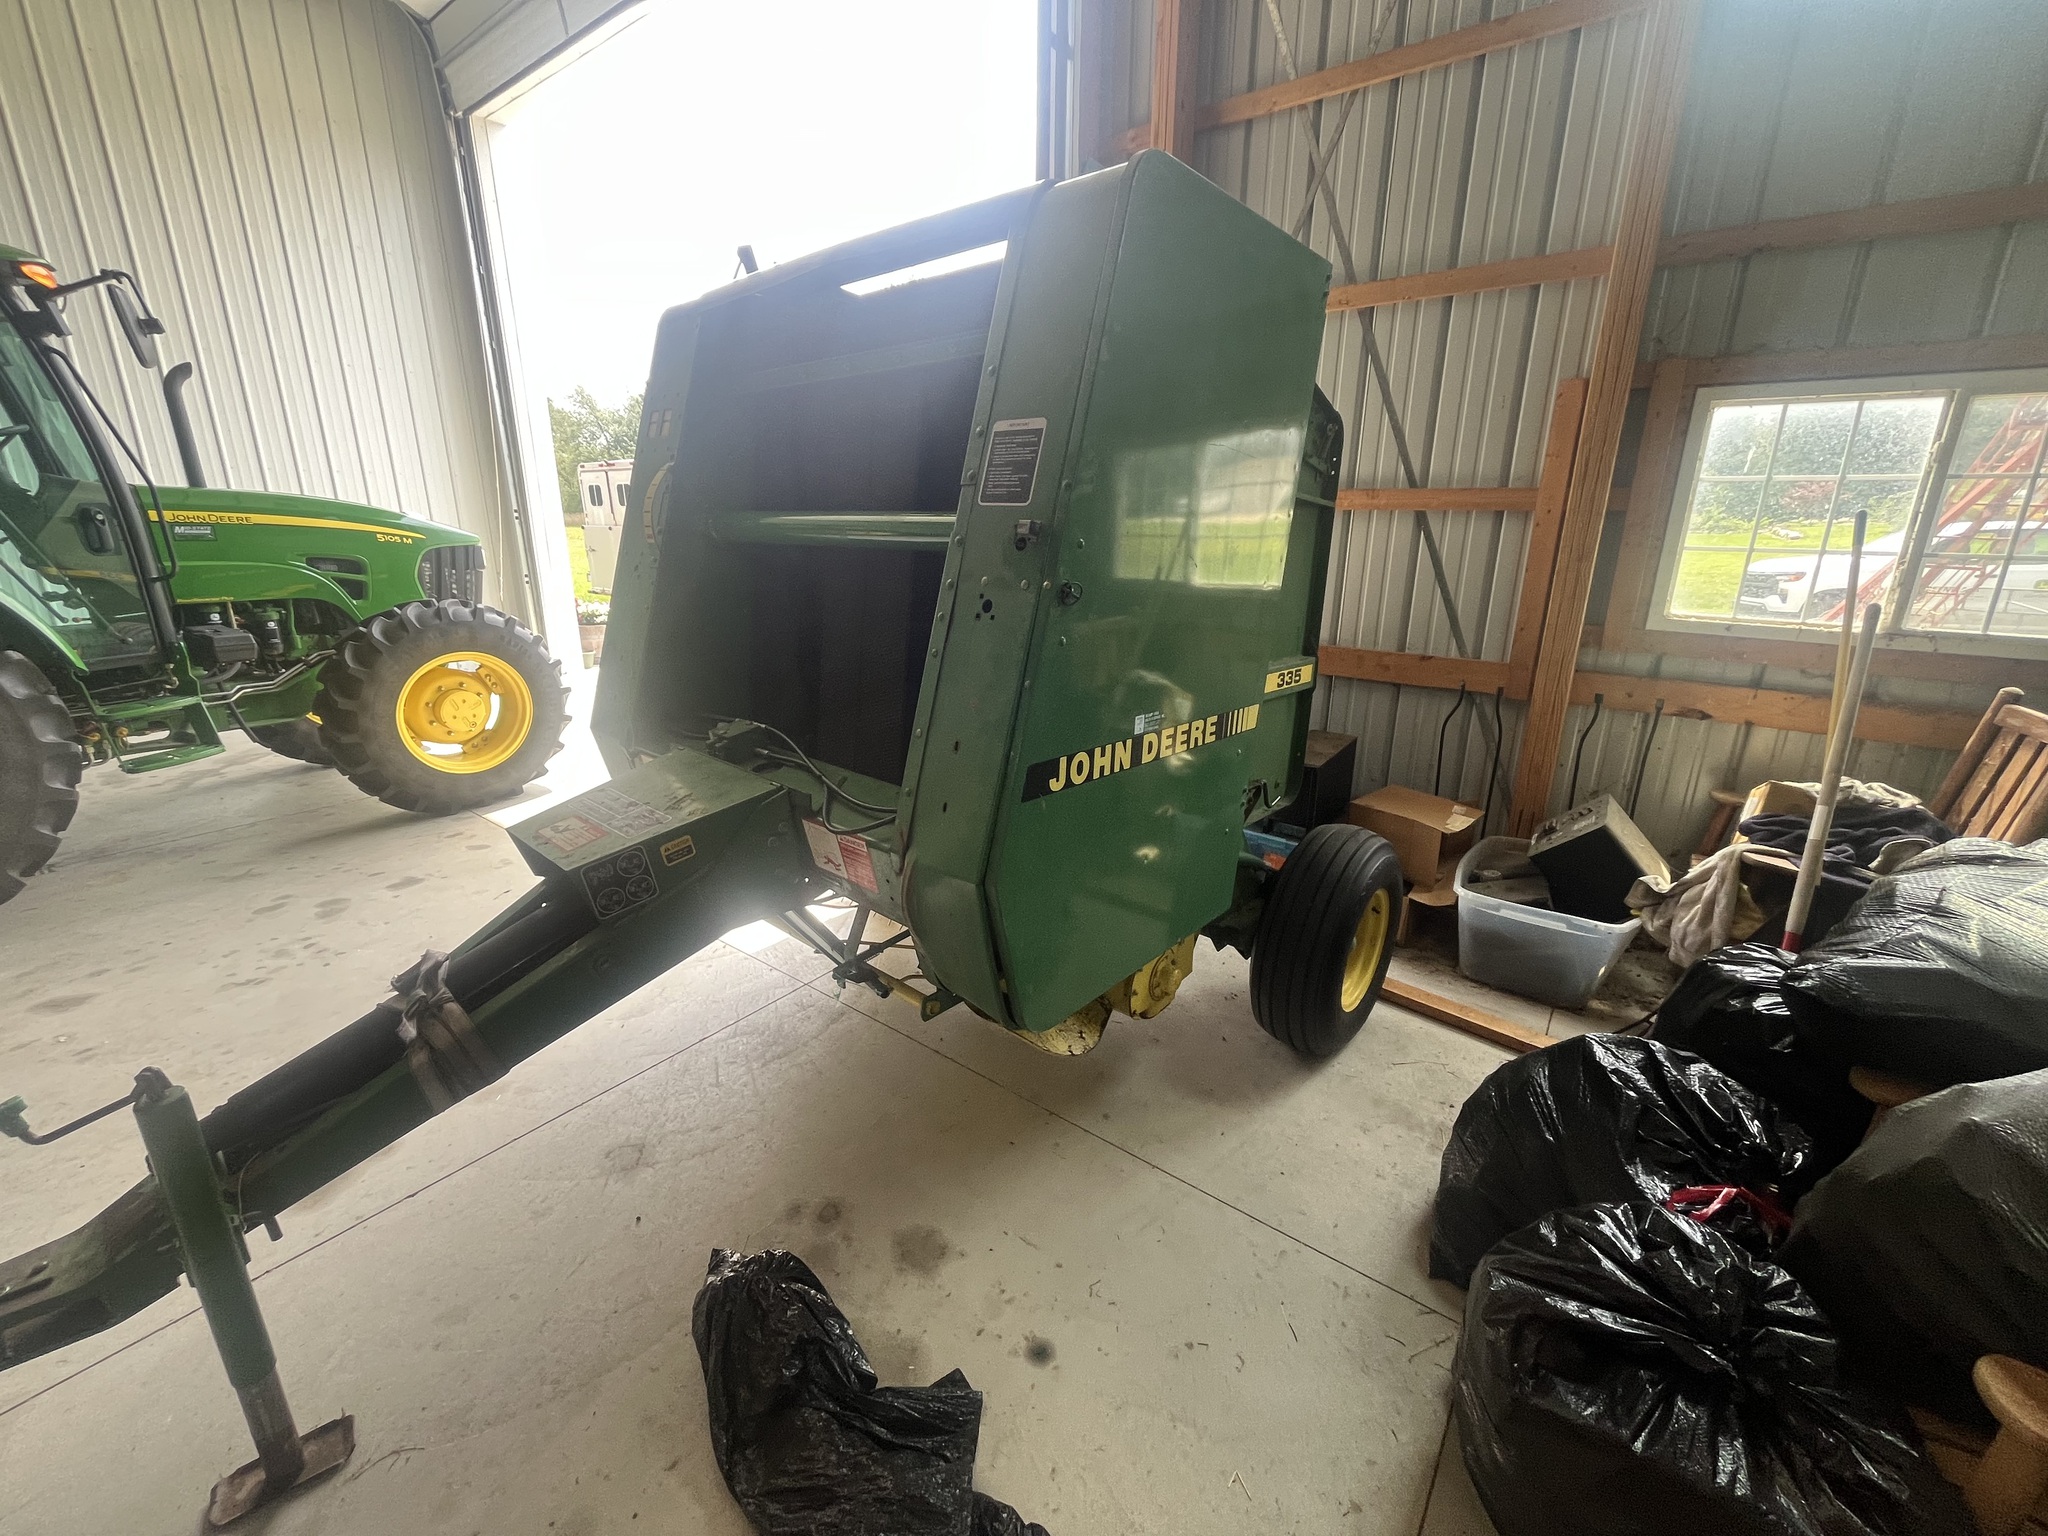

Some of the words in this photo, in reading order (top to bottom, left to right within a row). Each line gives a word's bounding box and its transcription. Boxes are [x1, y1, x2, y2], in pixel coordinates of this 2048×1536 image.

[169, 513, 206, 522] JOHN
[208, 513, 252, 523] DEERE
[1276, 668, 1302, 688] 335
[1049, 738, 1132, 792] JOHN
[1141, 715, 1218, 764] DEERE
